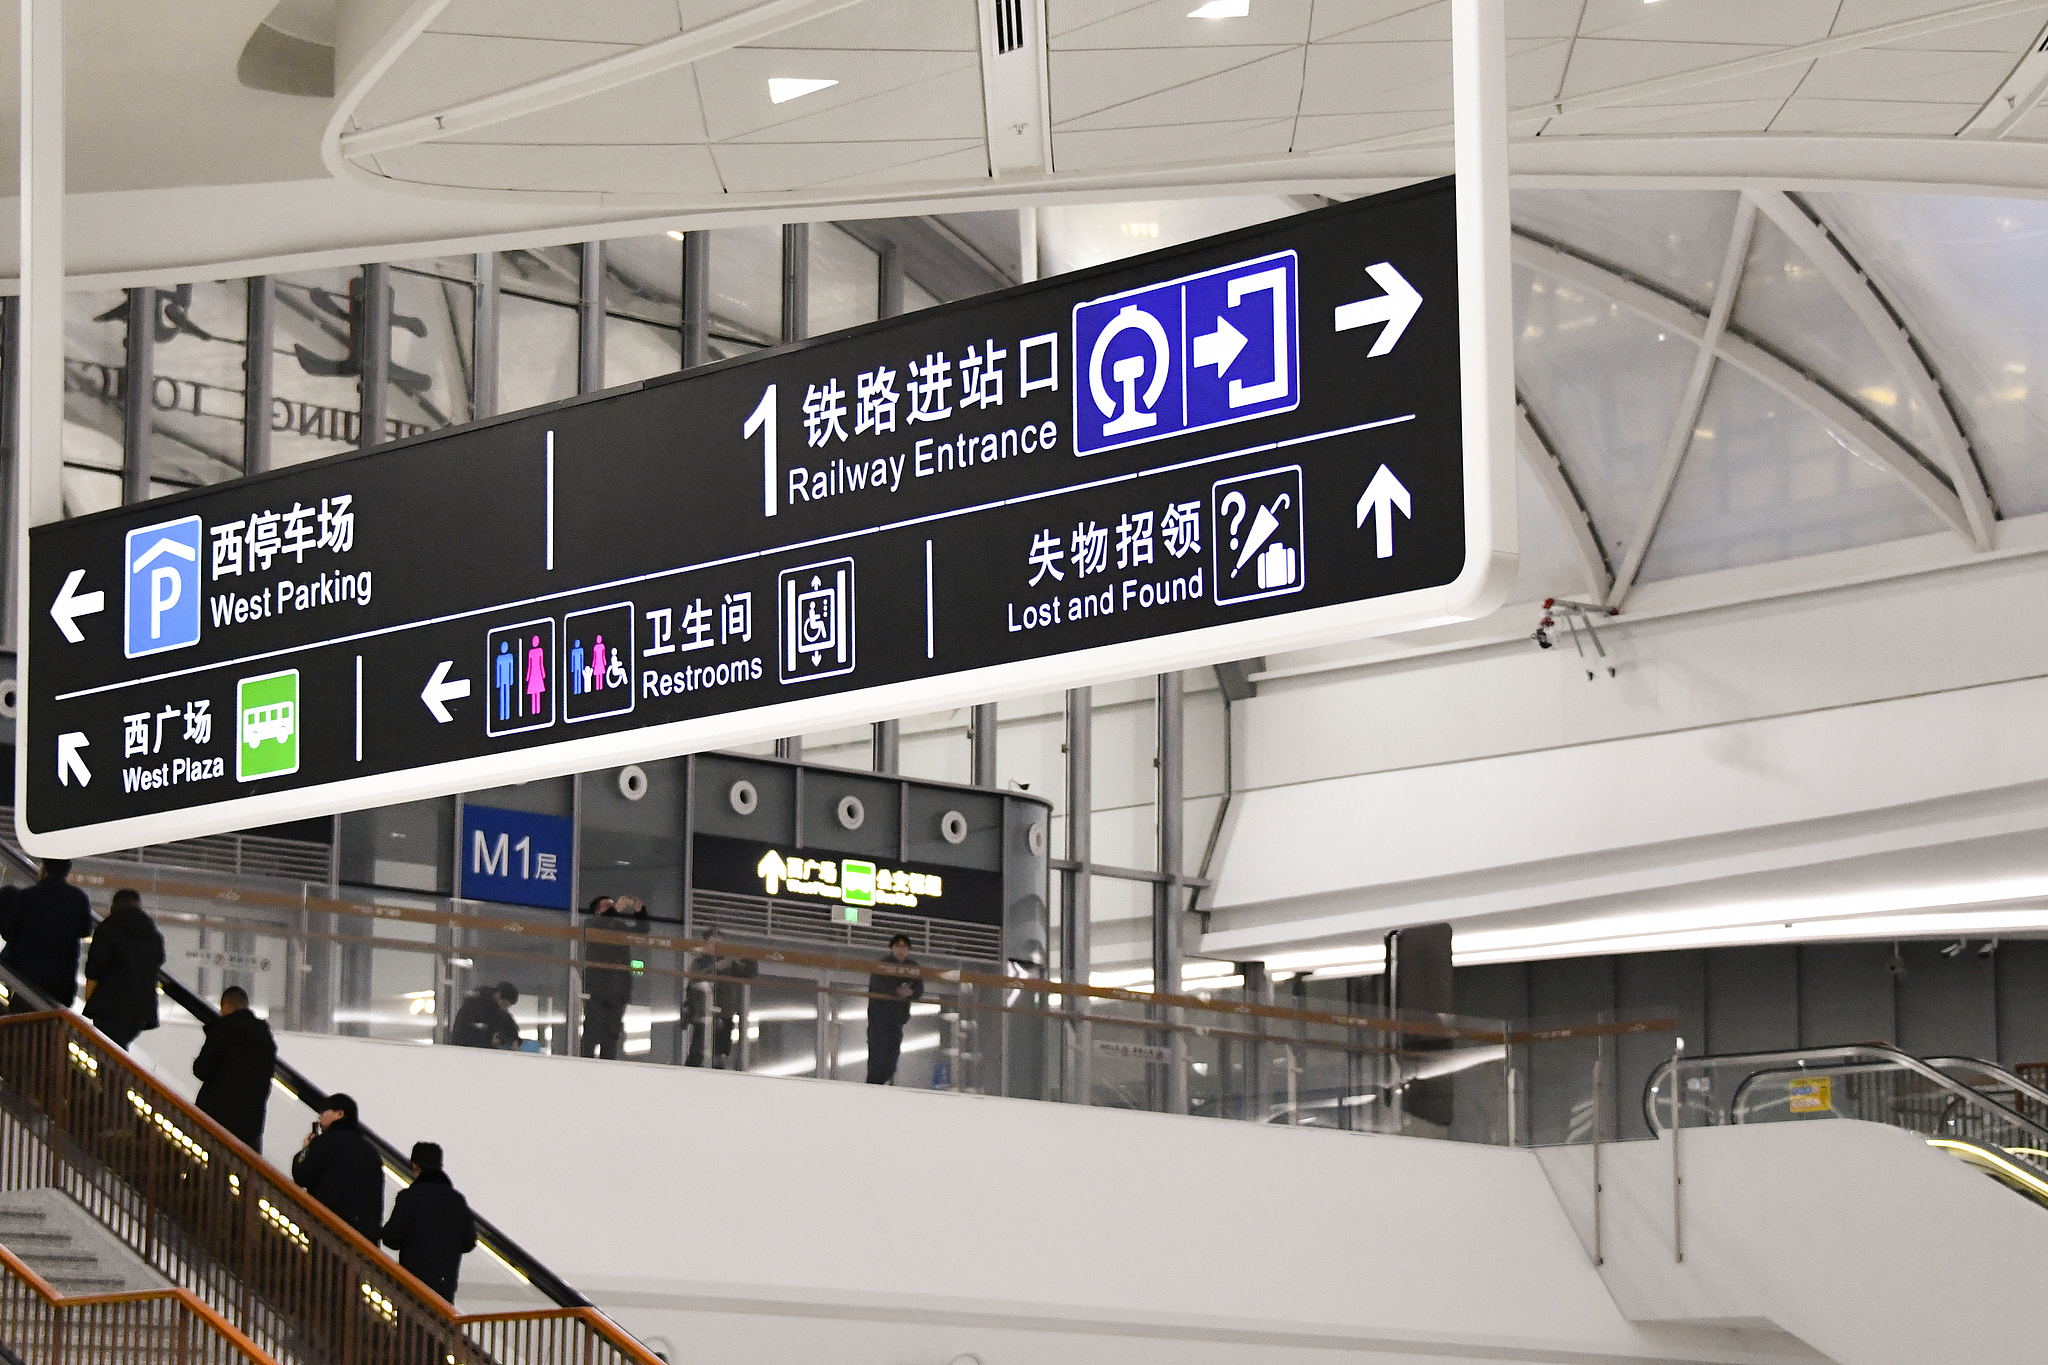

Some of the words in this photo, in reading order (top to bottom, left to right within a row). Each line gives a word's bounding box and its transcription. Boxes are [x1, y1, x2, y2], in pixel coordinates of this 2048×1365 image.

[802, 332, 1059, 448] 铁路进站口
[743, 383, 778, 518] 1
[788, 453, 905, 505] Railway
[914, 419, 1058, 478] Entrance
[209, 494, 356, 581] 西停车场
[1027, 500, 1202, 588] 失物招领
[210, 587, 272, 628] West
[277, 569, 373, 615] Parking
[642, 590, 753, 658] 卫生间
[1007, 596, 1061, 633] Lost
[1068, 580, 1114, 621] and
[1122, 567, 1204, 613] Found
[642, 655, 764, 699] Restrooms
[122, 699, 212, 759] 西广场
[121, 763, 170, 794] West
[172, 756, 225, 785] Plaza
